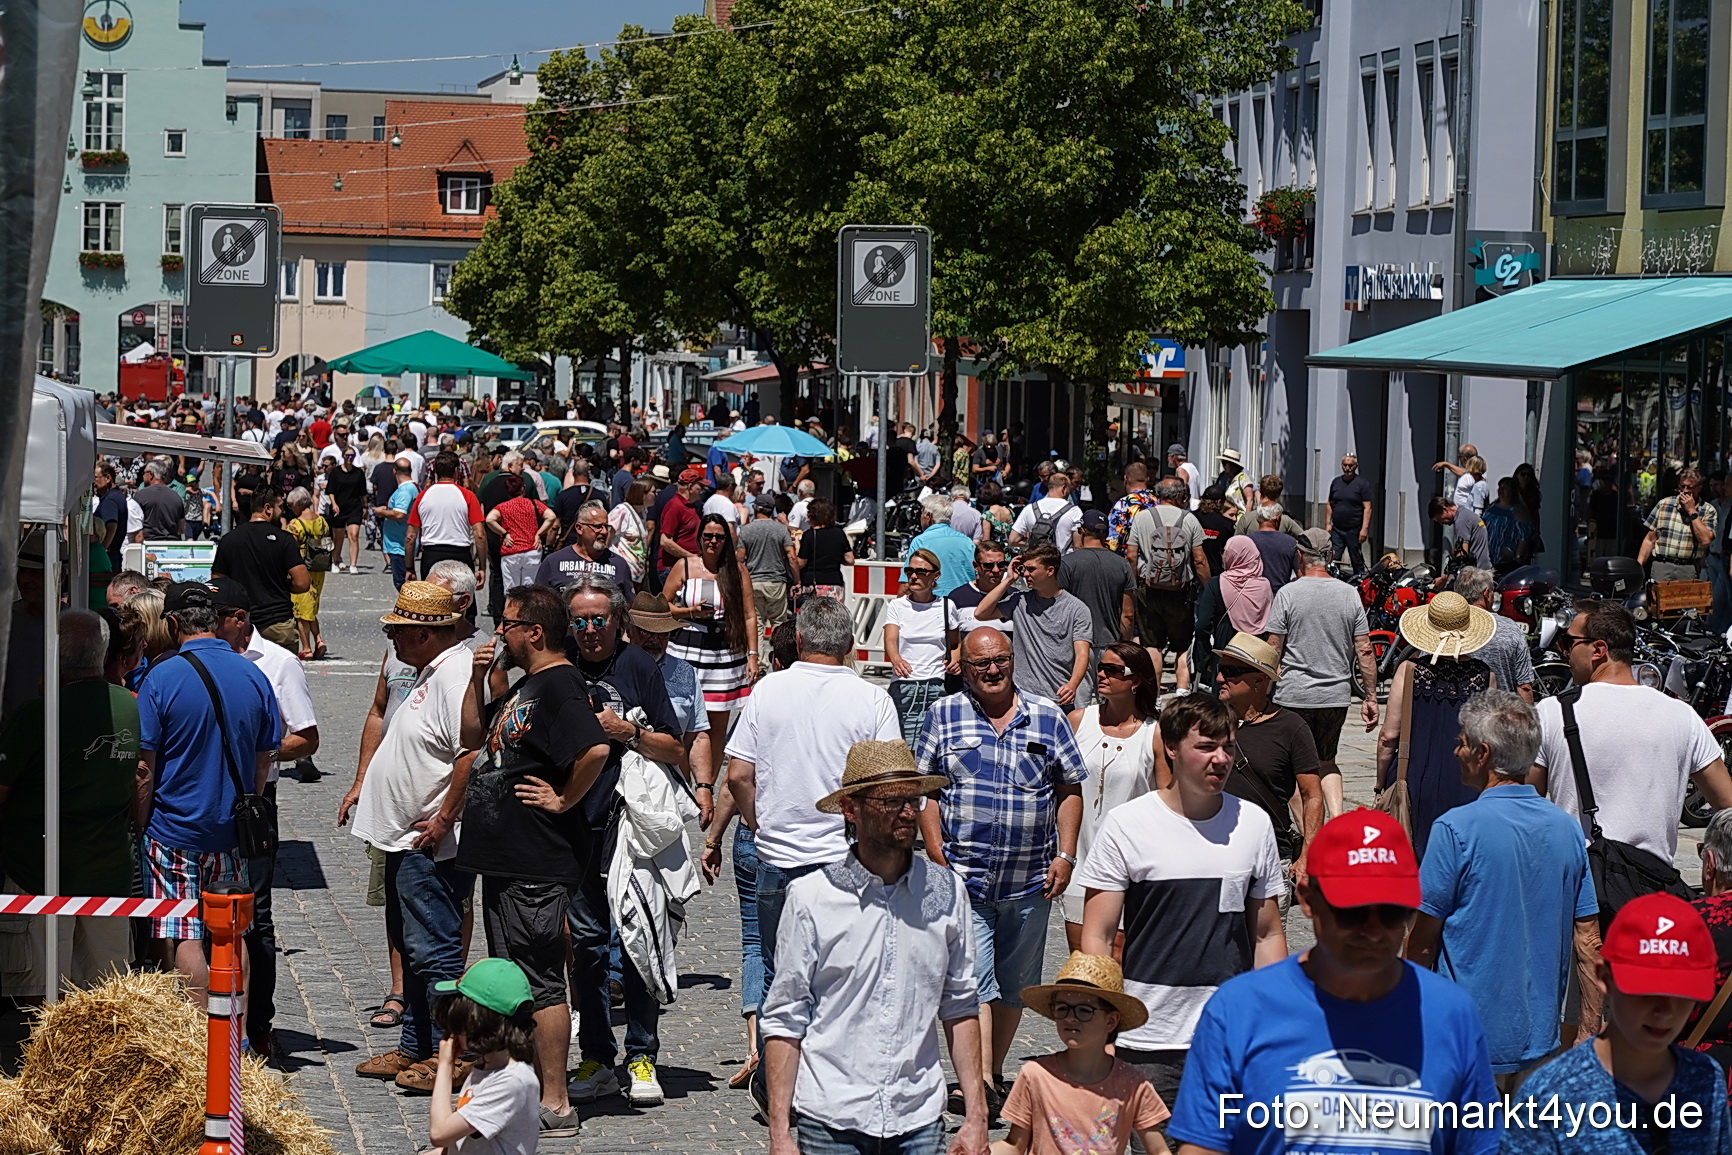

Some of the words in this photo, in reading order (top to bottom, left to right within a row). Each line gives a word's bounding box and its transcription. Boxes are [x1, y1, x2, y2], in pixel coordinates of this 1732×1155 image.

[216, 269, 250, 281] ZONE
[1495, 253, 1522, 286] G2
[1362, 262, 1436, 299] Raiffeisenbank
[868, 290, 901, 302] ZONE
[559, 560, 585, 572] URBAN
[587, 562, 616, 577] FEELING
[1347, 847, 1398, 866] DEKRA
[1639, 938, 1690, 957] DEKRA
